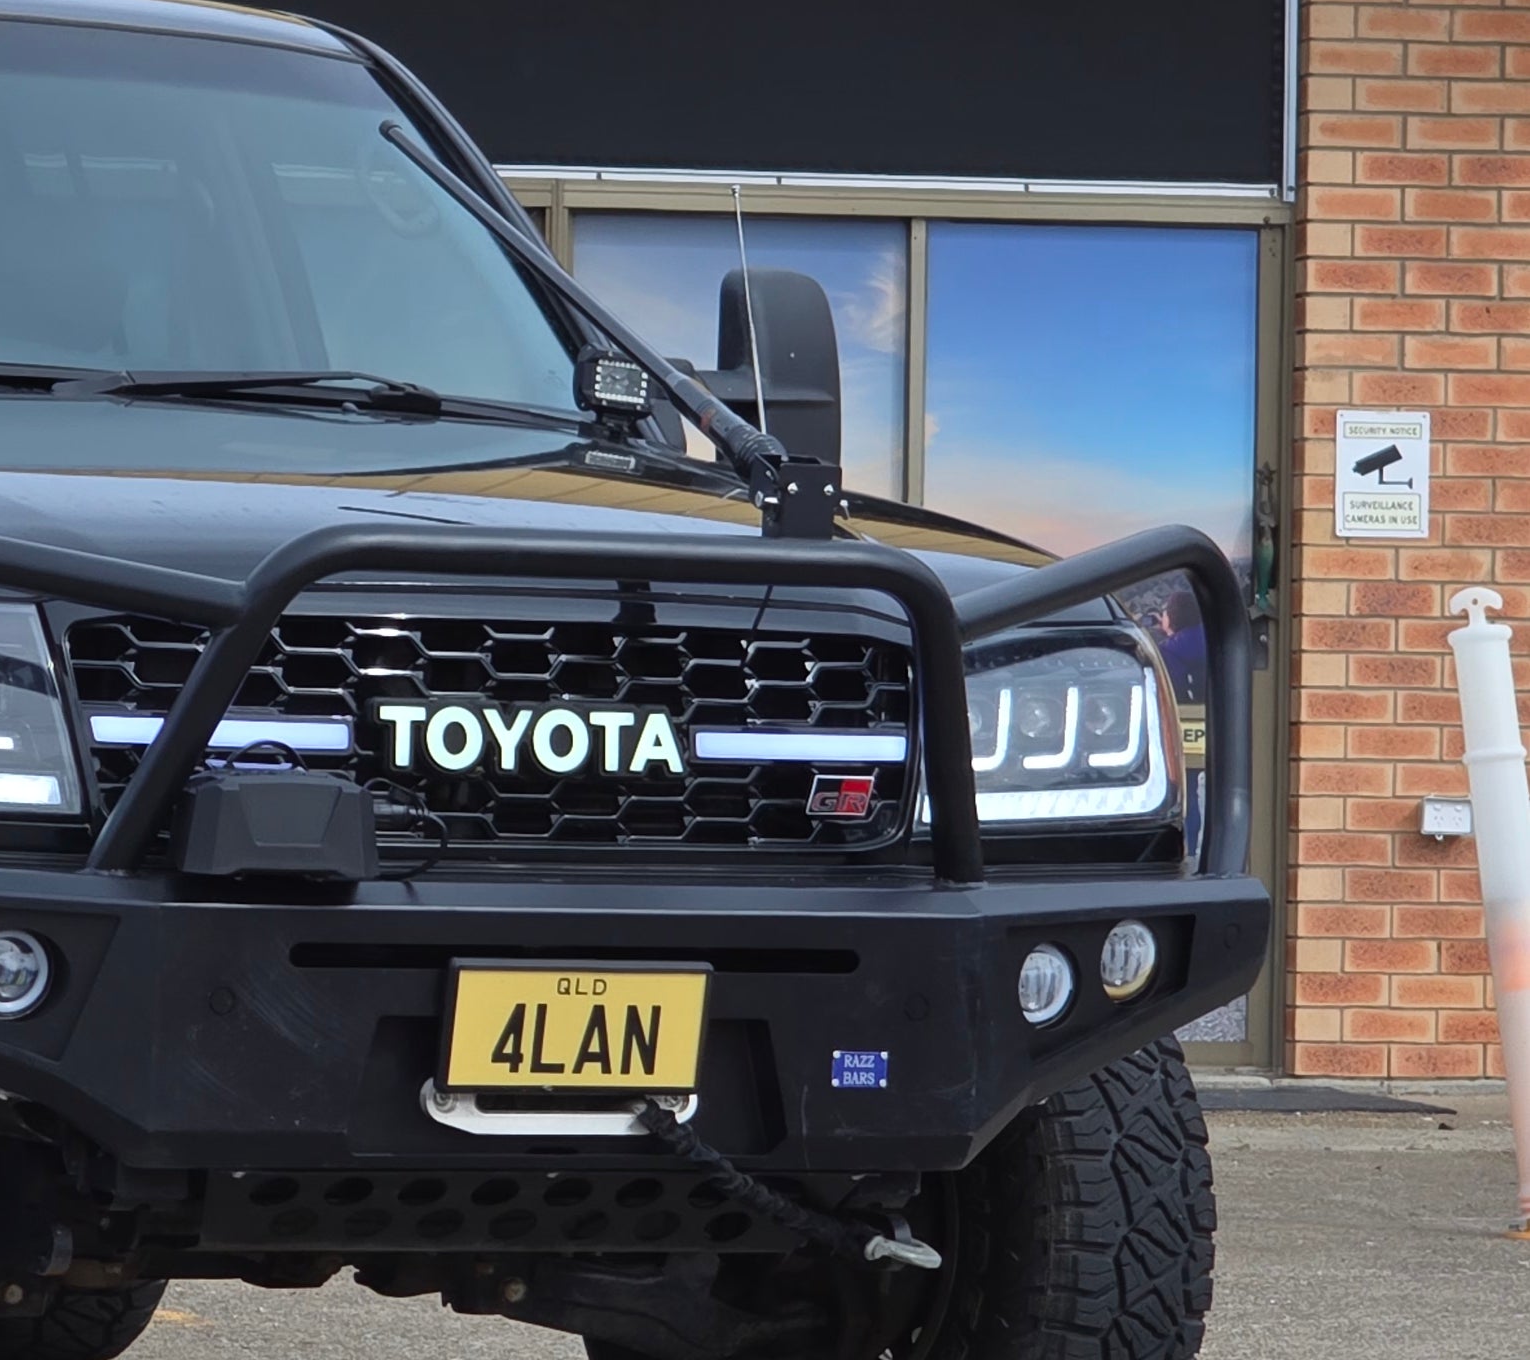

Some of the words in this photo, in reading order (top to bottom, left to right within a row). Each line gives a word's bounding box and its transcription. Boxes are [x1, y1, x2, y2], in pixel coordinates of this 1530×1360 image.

[1348, 425, 1387, 436] SECURITY
[1390, 426, 1418, 436] NOTICE
[1349, 500, 1414, 511] SURVEILLANCE
[1344, 513, 1386, 524] CAMERAS
[1388, 514, 1398, 525] IN
[1400, 515, 1418, 525] USE
[379, 705, 684, 773] TOYOTA
[811, 791, 868, 813] GR
[556, 977, 607, 996] QLD
[490, 1002, 662, 1076] 4LAN
[843, 1053, 876, 1069] RAZZ
[842, 1070, 876, 1086] BARS
